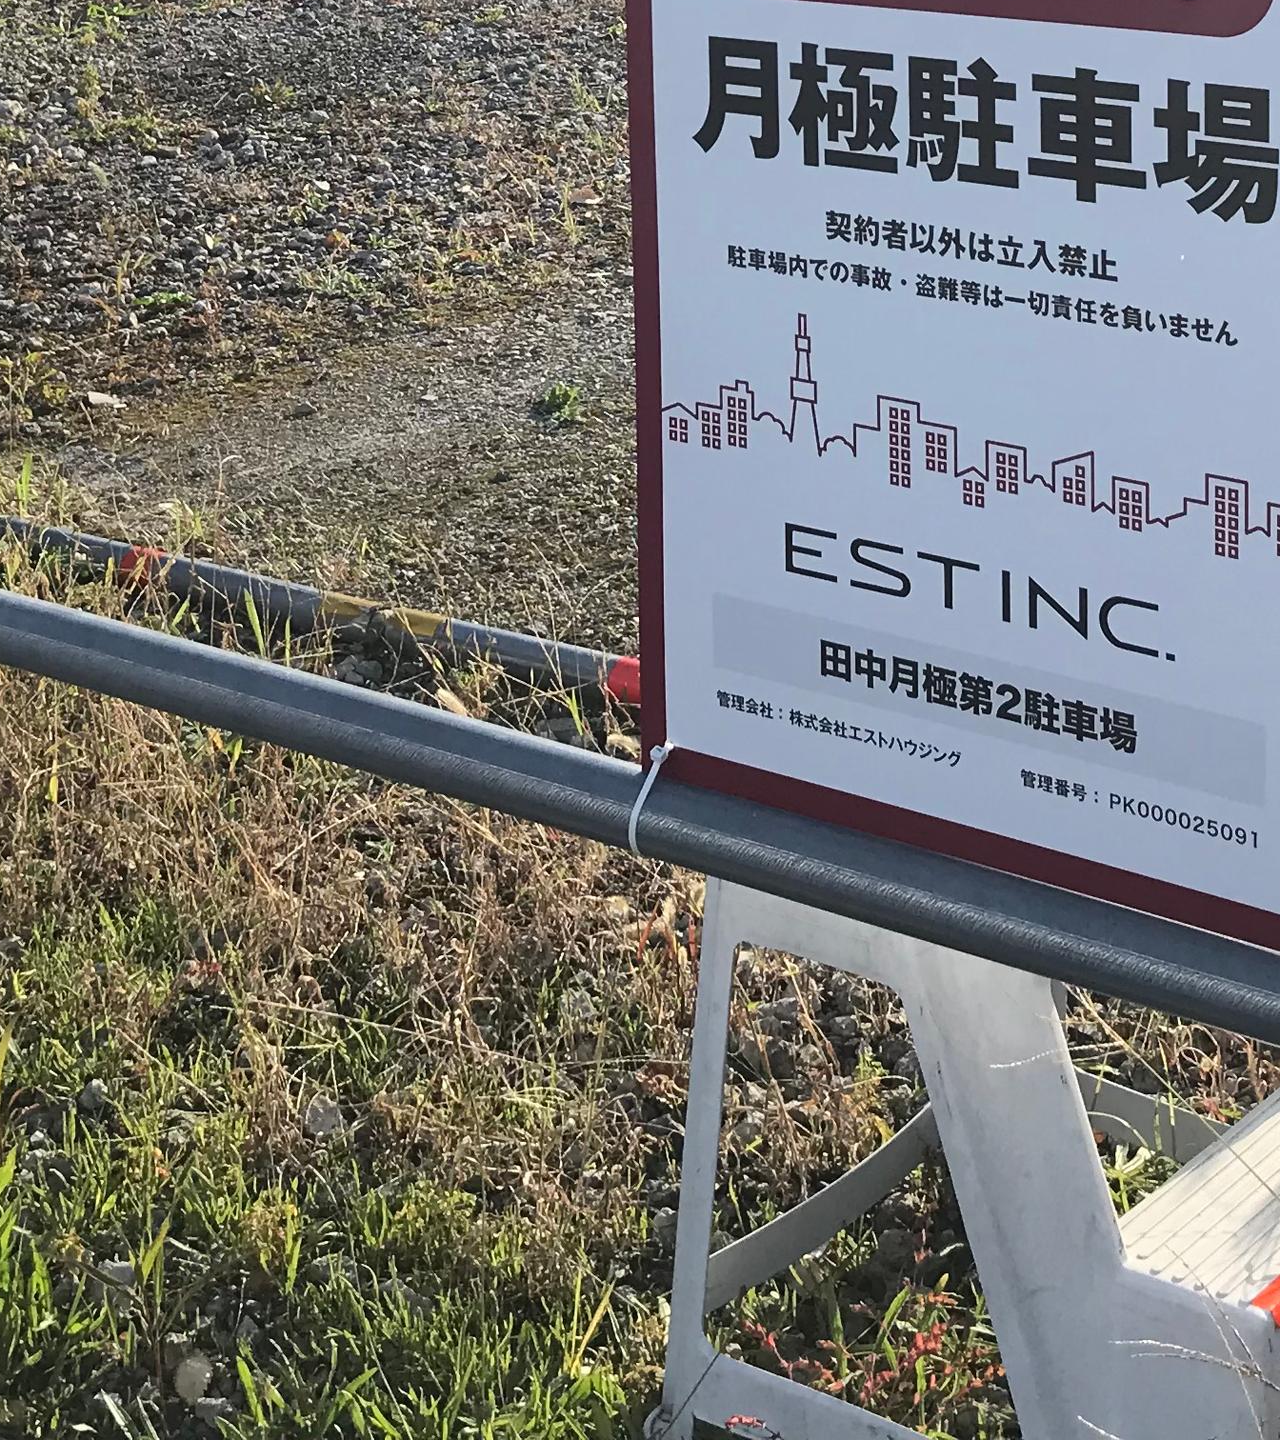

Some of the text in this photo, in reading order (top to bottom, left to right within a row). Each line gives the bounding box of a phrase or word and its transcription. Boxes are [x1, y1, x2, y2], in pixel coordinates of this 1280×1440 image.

[693, 35, 1280, 225] 月極駐車場
[727, 245, 1239, 347] 駐車場内での事故・盗難等は一切責任を負いません
[824, 210, 1119, 283] 契約者以外は立入禁止
[820, 638, 1138, 755] 田中月極第2駐車場
